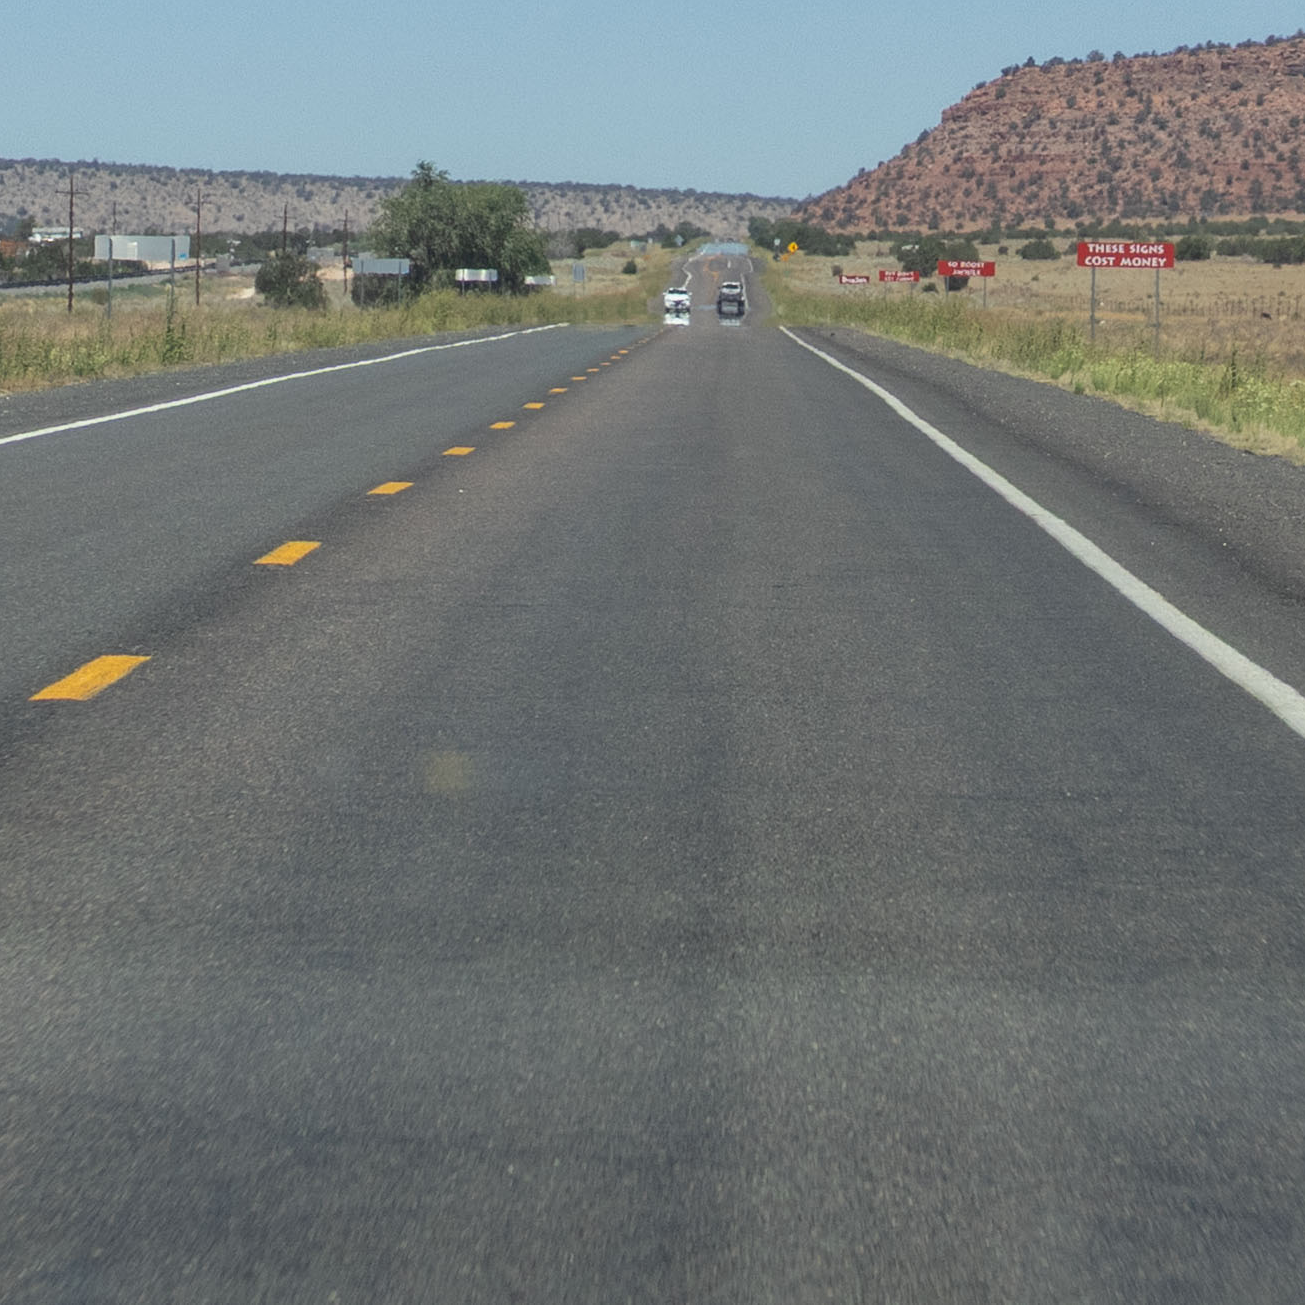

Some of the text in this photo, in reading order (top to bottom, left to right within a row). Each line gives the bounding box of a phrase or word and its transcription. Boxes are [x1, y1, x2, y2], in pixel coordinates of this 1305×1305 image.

[1087, 243, 1164, 254] THESE SIGNS
[1085, 256, 1166, 267] COST MONEY
